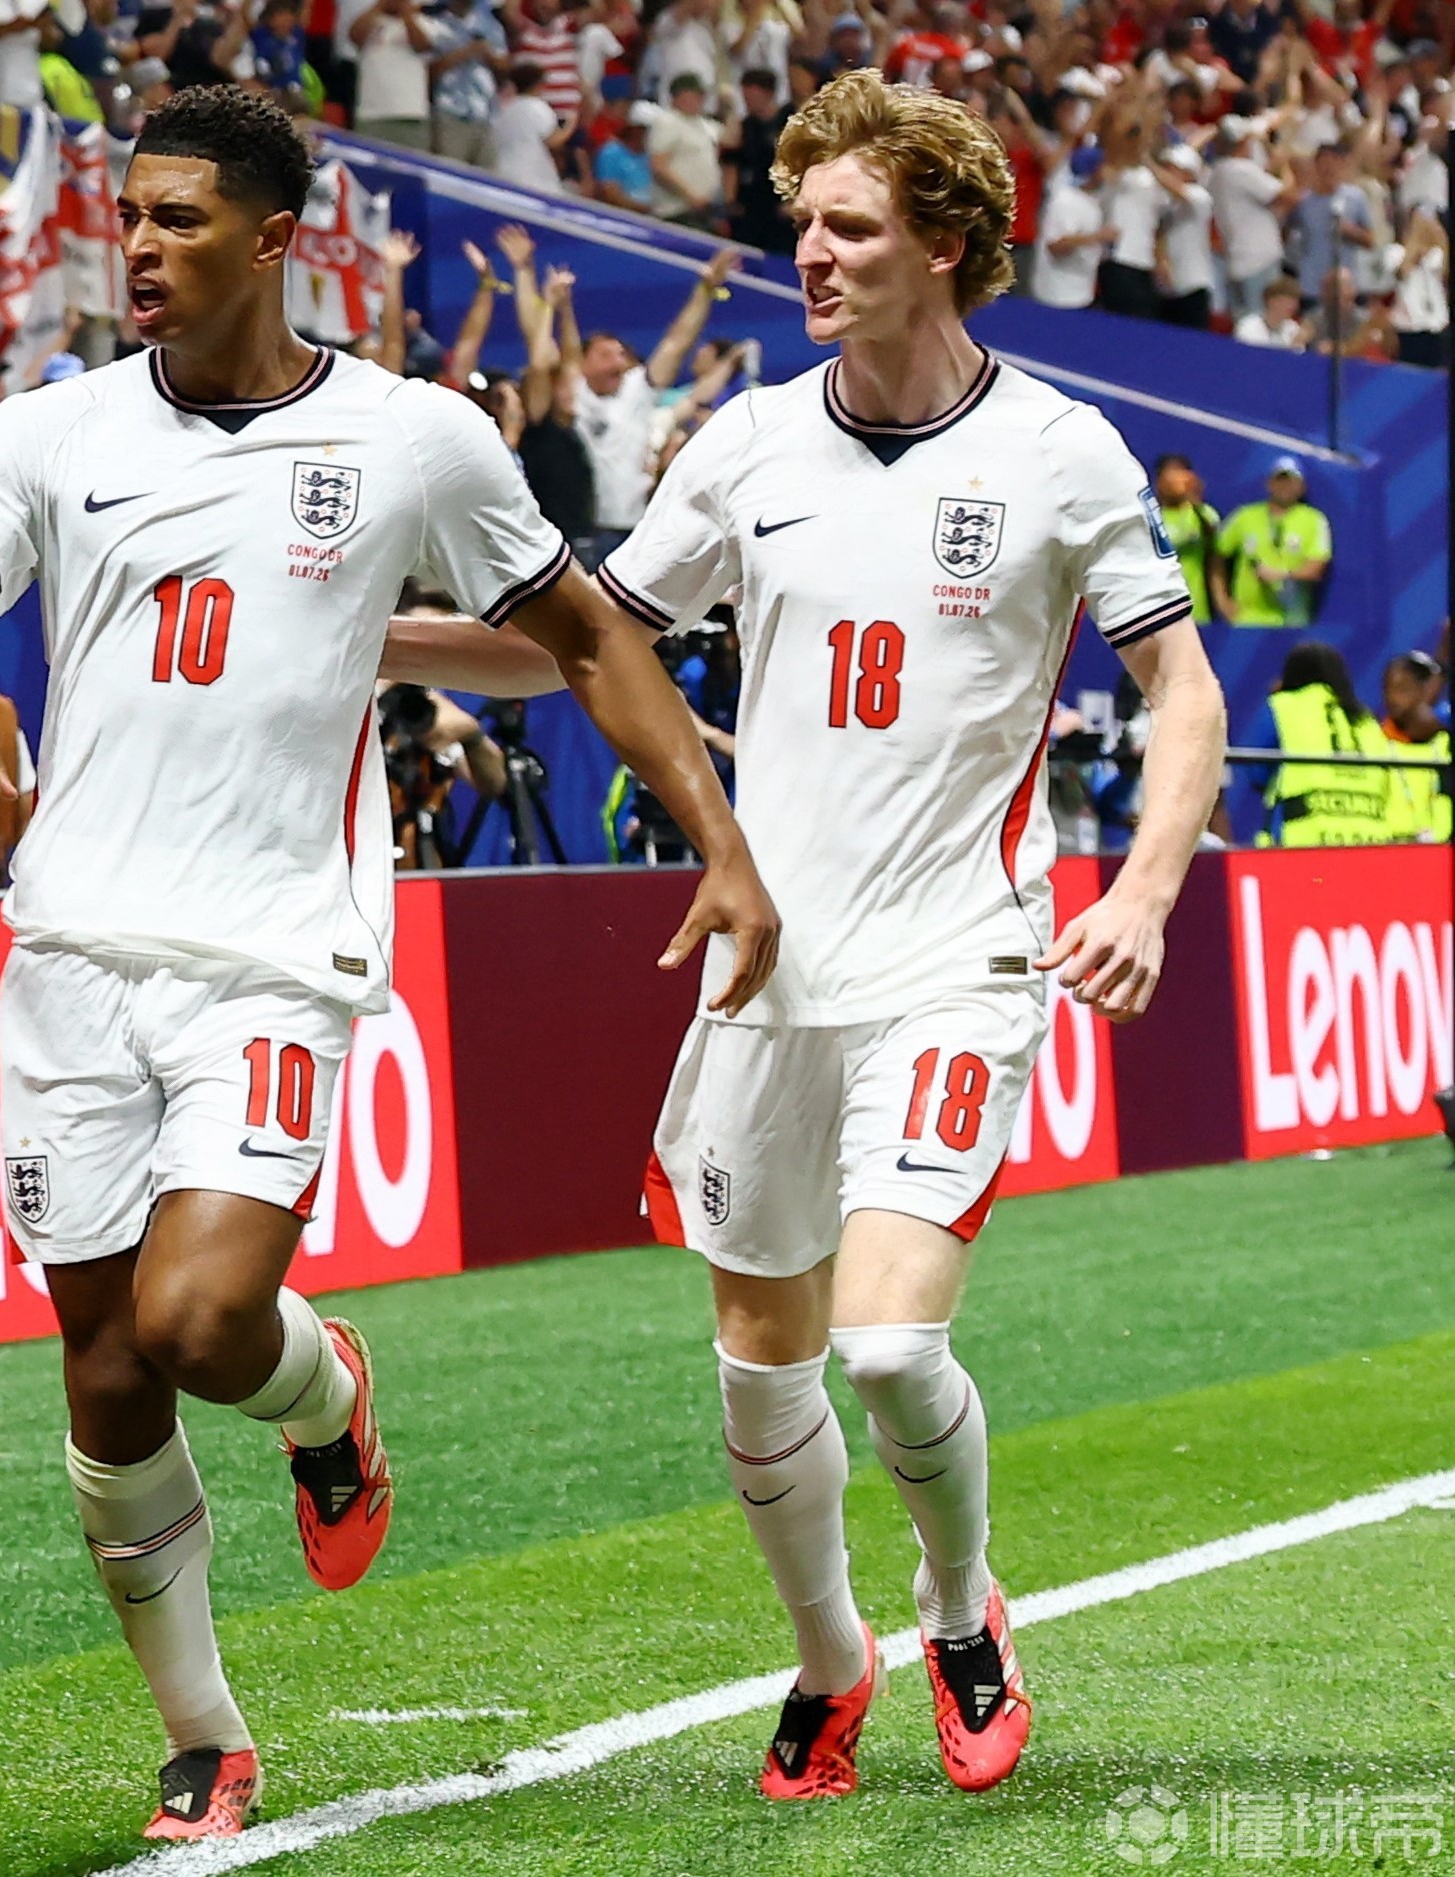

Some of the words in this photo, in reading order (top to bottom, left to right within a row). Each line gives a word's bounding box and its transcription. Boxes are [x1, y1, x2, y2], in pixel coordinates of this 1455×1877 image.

[287, 543, 327, 561] CONGO
[328, 548, 343, 564] DR
[932, 584, 973, 600] CONGO
[975, 587, 991, 601] DR
[152, 575, 235, 686] 10
[828, 619, 906, 729] 18
[243, 1037, 316, 1142] 10
[902, 1046, 990, 1152] 18
